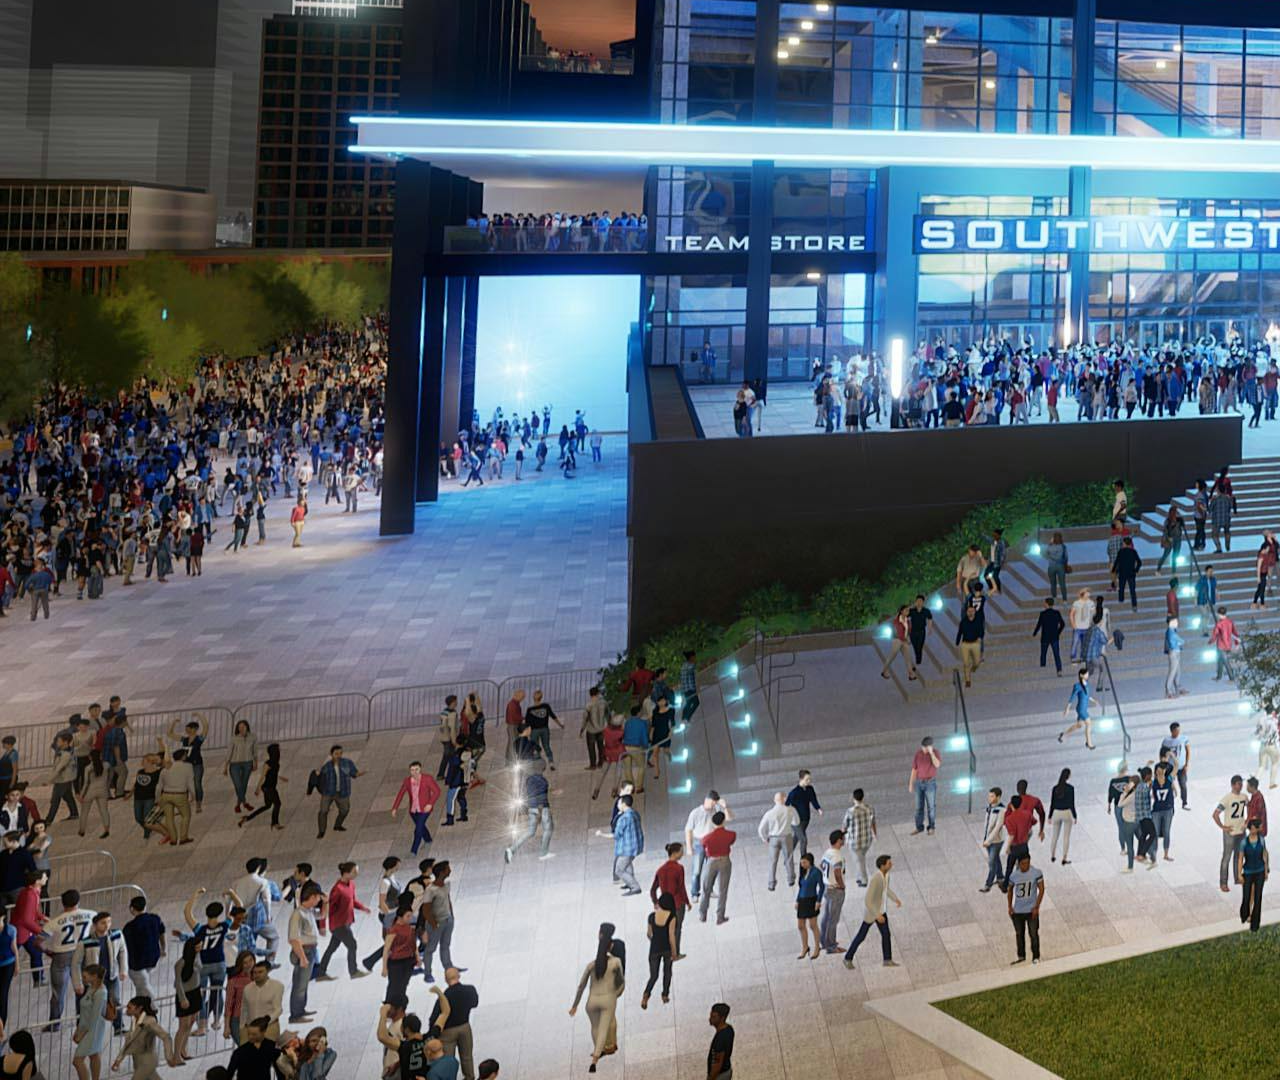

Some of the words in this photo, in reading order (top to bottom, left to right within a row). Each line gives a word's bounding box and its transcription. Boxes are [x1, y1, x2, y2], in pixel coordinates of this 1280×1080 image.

[664, 235, 750, 252] TEAM
[770, 234, 866, 252] STORE
[1156, 788, 1169, 801] 17
[1230, 800, 1246, 819] 27
[1015, 881, 1032, 898] 31
[61, 921, 90, 946] 27
[202, 933, 222, 950] 17
